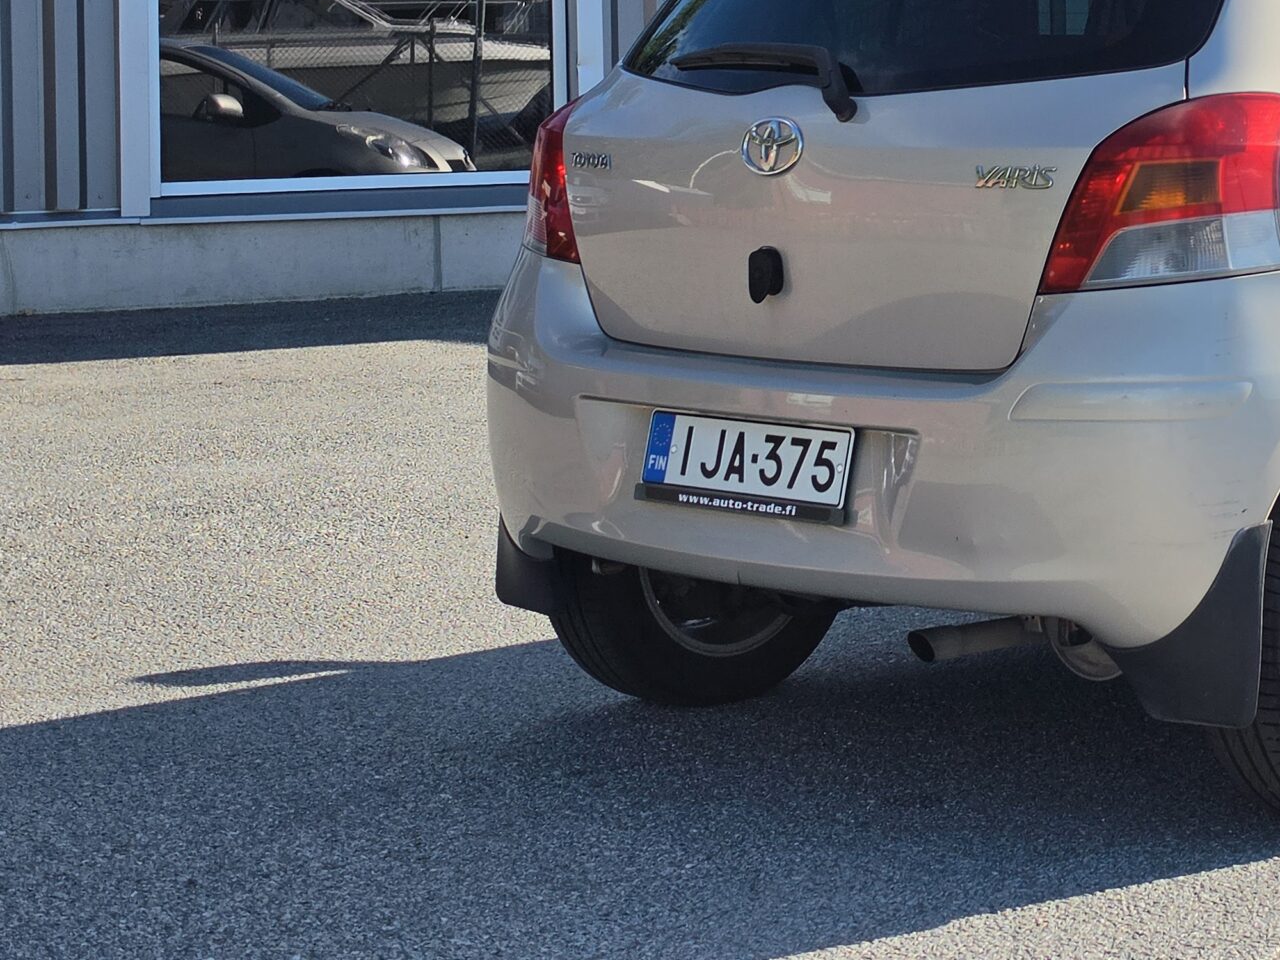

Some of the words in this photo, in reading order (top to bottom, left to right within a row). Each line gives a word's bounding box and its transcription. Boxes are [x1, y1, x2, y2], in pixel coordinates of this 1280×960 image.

[647, 454, 667, 471] FIN
[680, 425, 838, 493] IJA-375
[678, 493, 797, 517] www.auto-trade.fi
